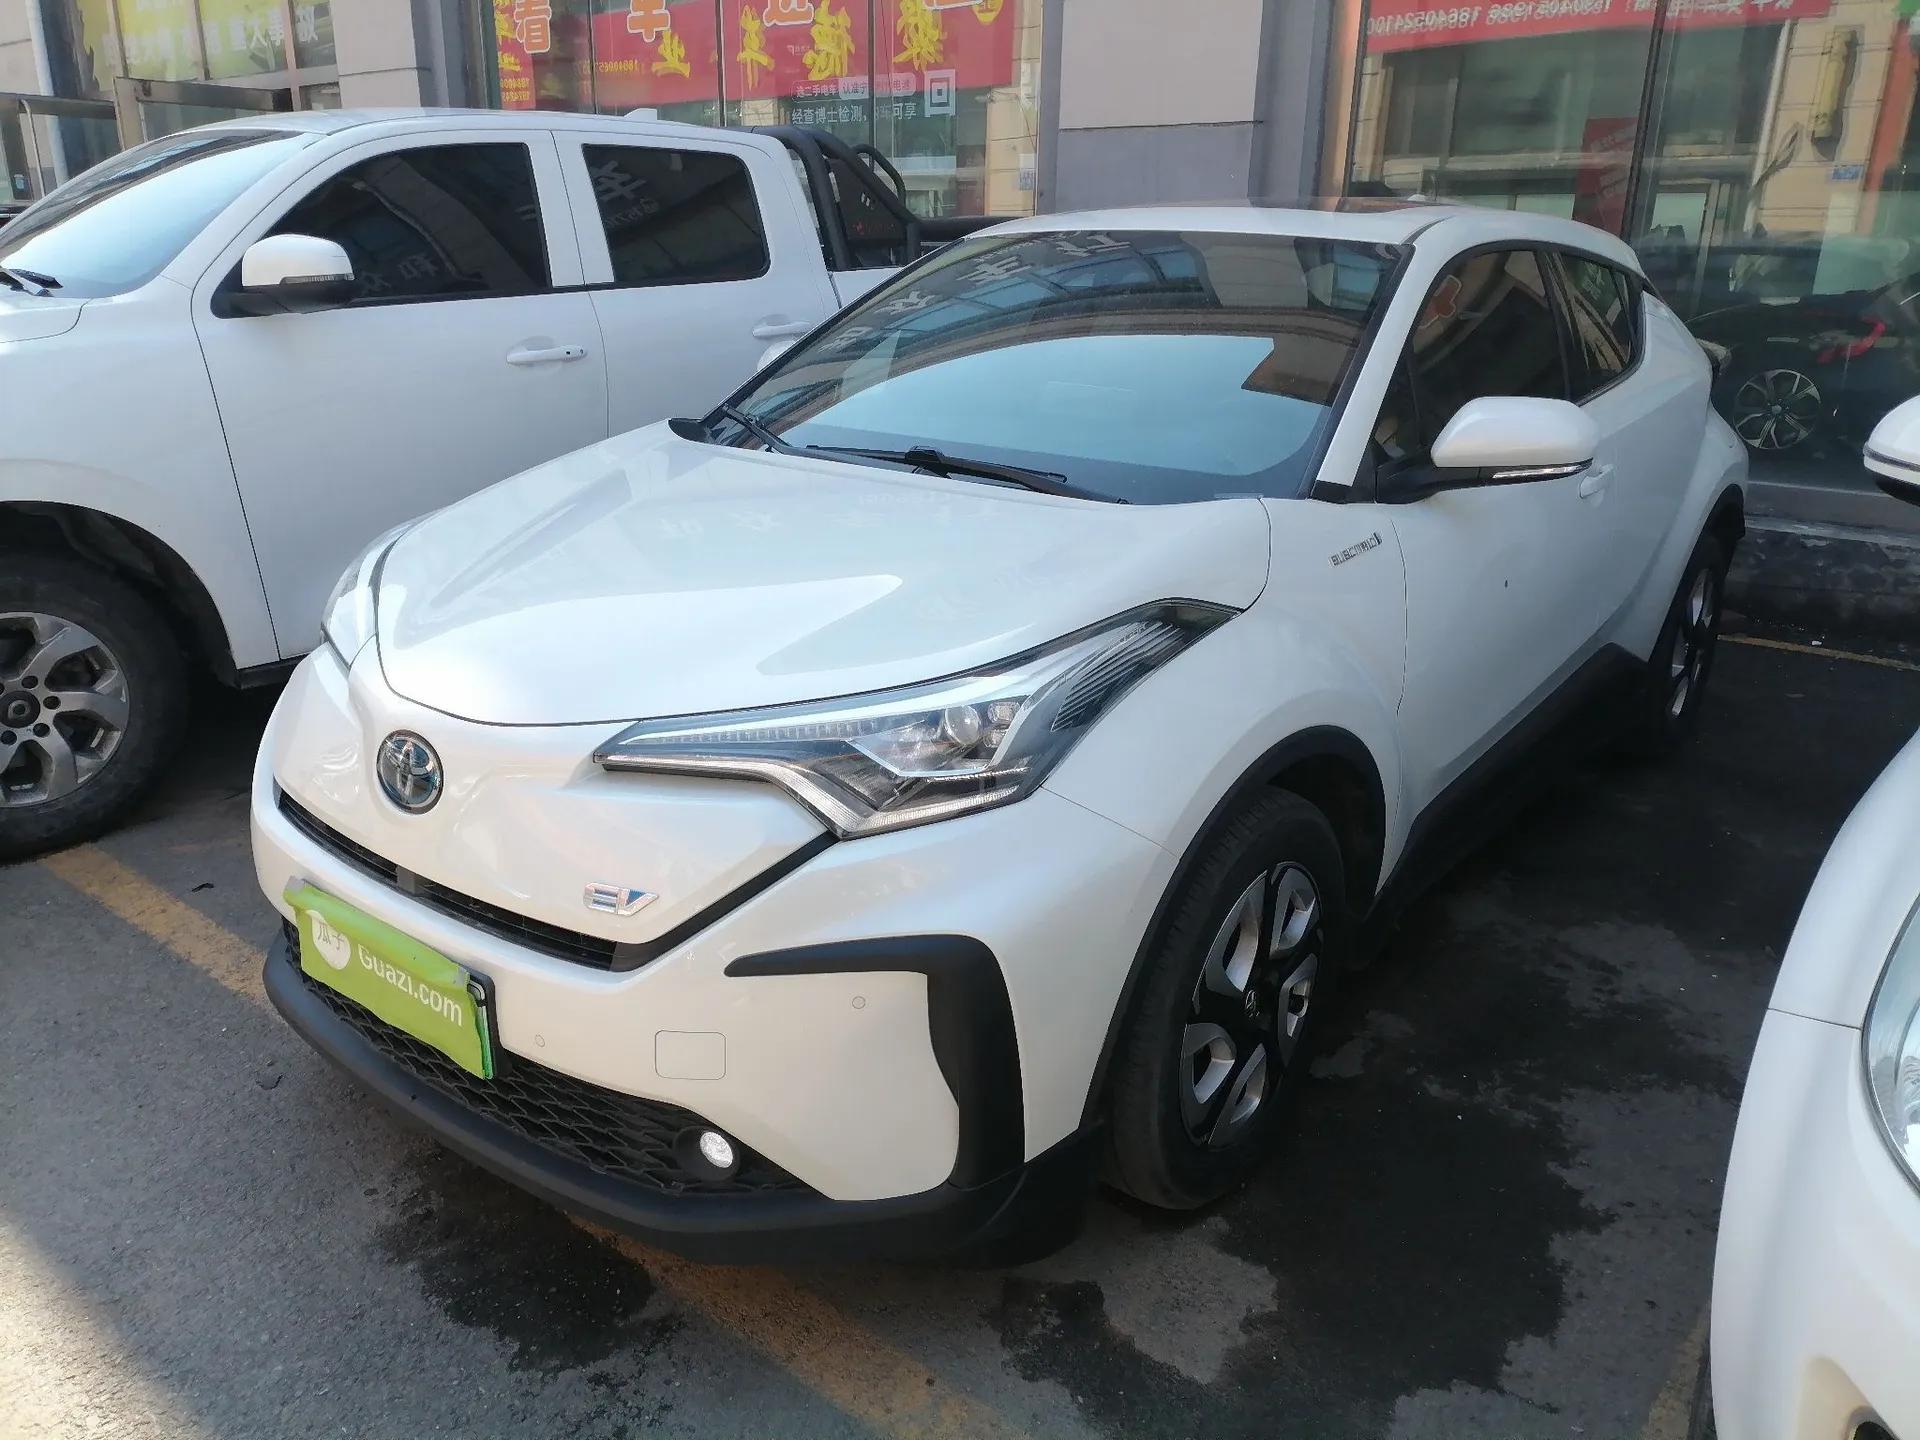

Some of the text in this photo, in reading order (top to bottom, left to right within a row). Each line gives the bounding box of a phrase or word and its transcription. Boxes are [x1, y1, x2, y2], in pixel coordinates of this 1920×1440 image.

[583, 882, 660, 917] EV
[316, 920, 347, 952] 瓜子
[358, 942, 463, 1027] Guazi.com
